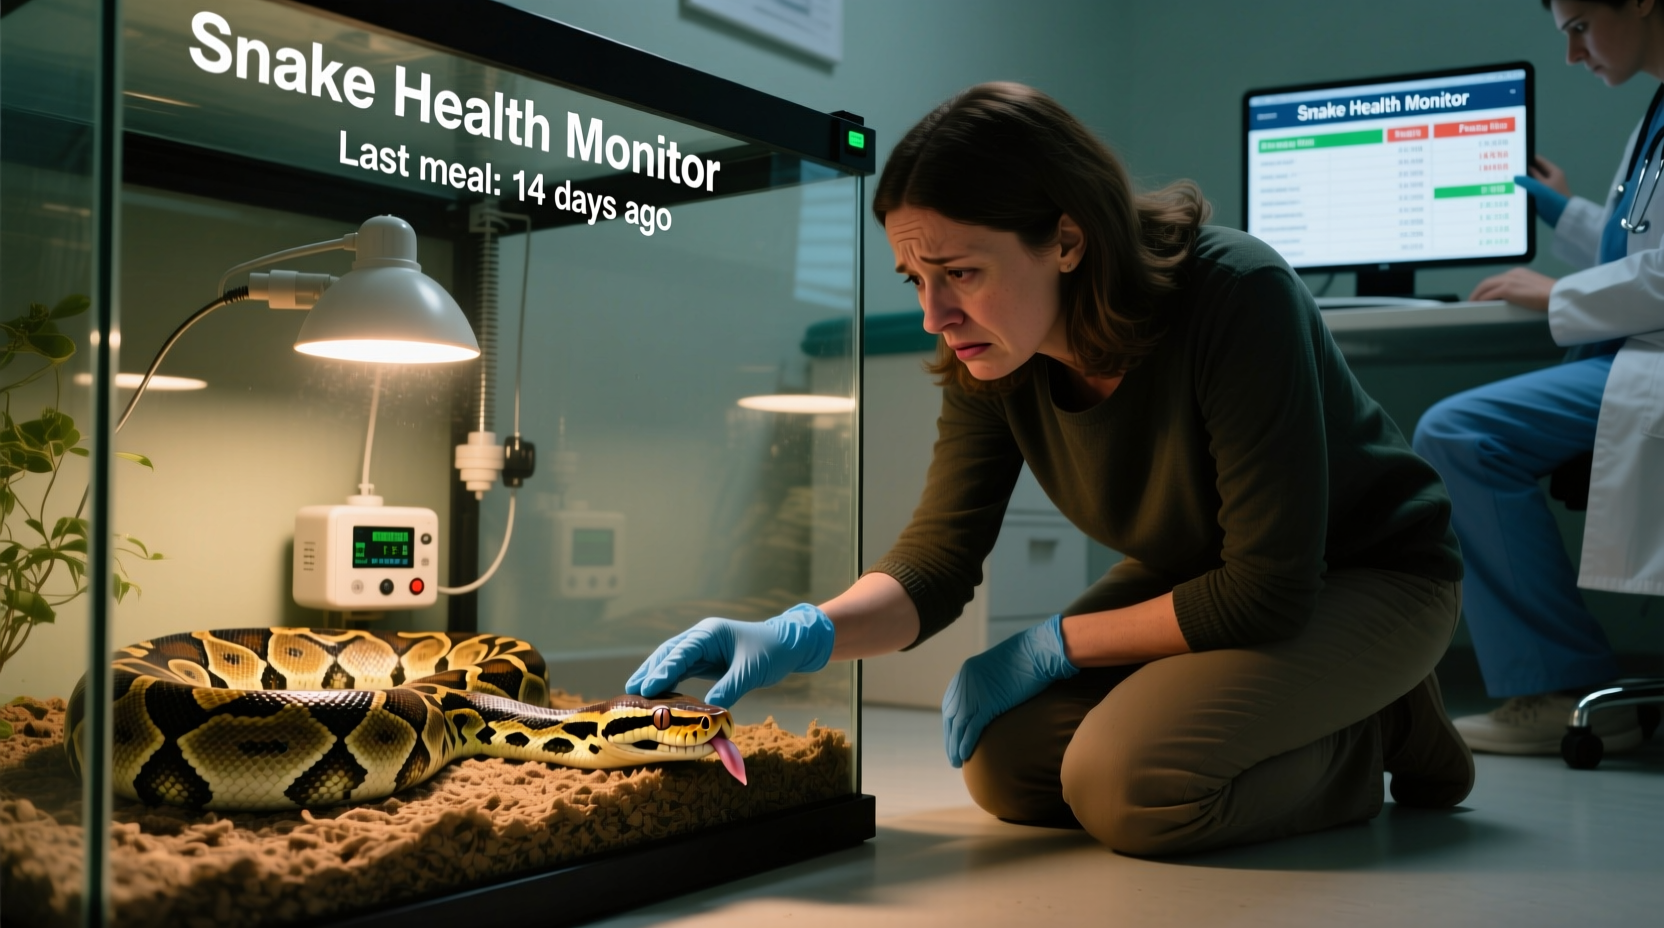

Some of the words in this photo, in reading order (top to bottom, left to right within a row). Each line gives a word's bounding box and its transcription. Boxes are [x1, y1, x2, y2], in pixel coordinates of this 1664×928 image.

[188, 10, 376, 109] Snake
[394, 64, 551, 153] Health
[566, 110, 721, 192] Monitor
[1297, 102, 1346, 121] Snake
[1350, 95, 1401, 116] Health
[1405, 91, 1470, 111] Monitor
[339, 129, 410, 178] Last
[419, 155, 501, 196] meal:
[512, 169, 546, 206] 14
[554, 179, 617, 226] days
[624, 200, 673, 237] ago
